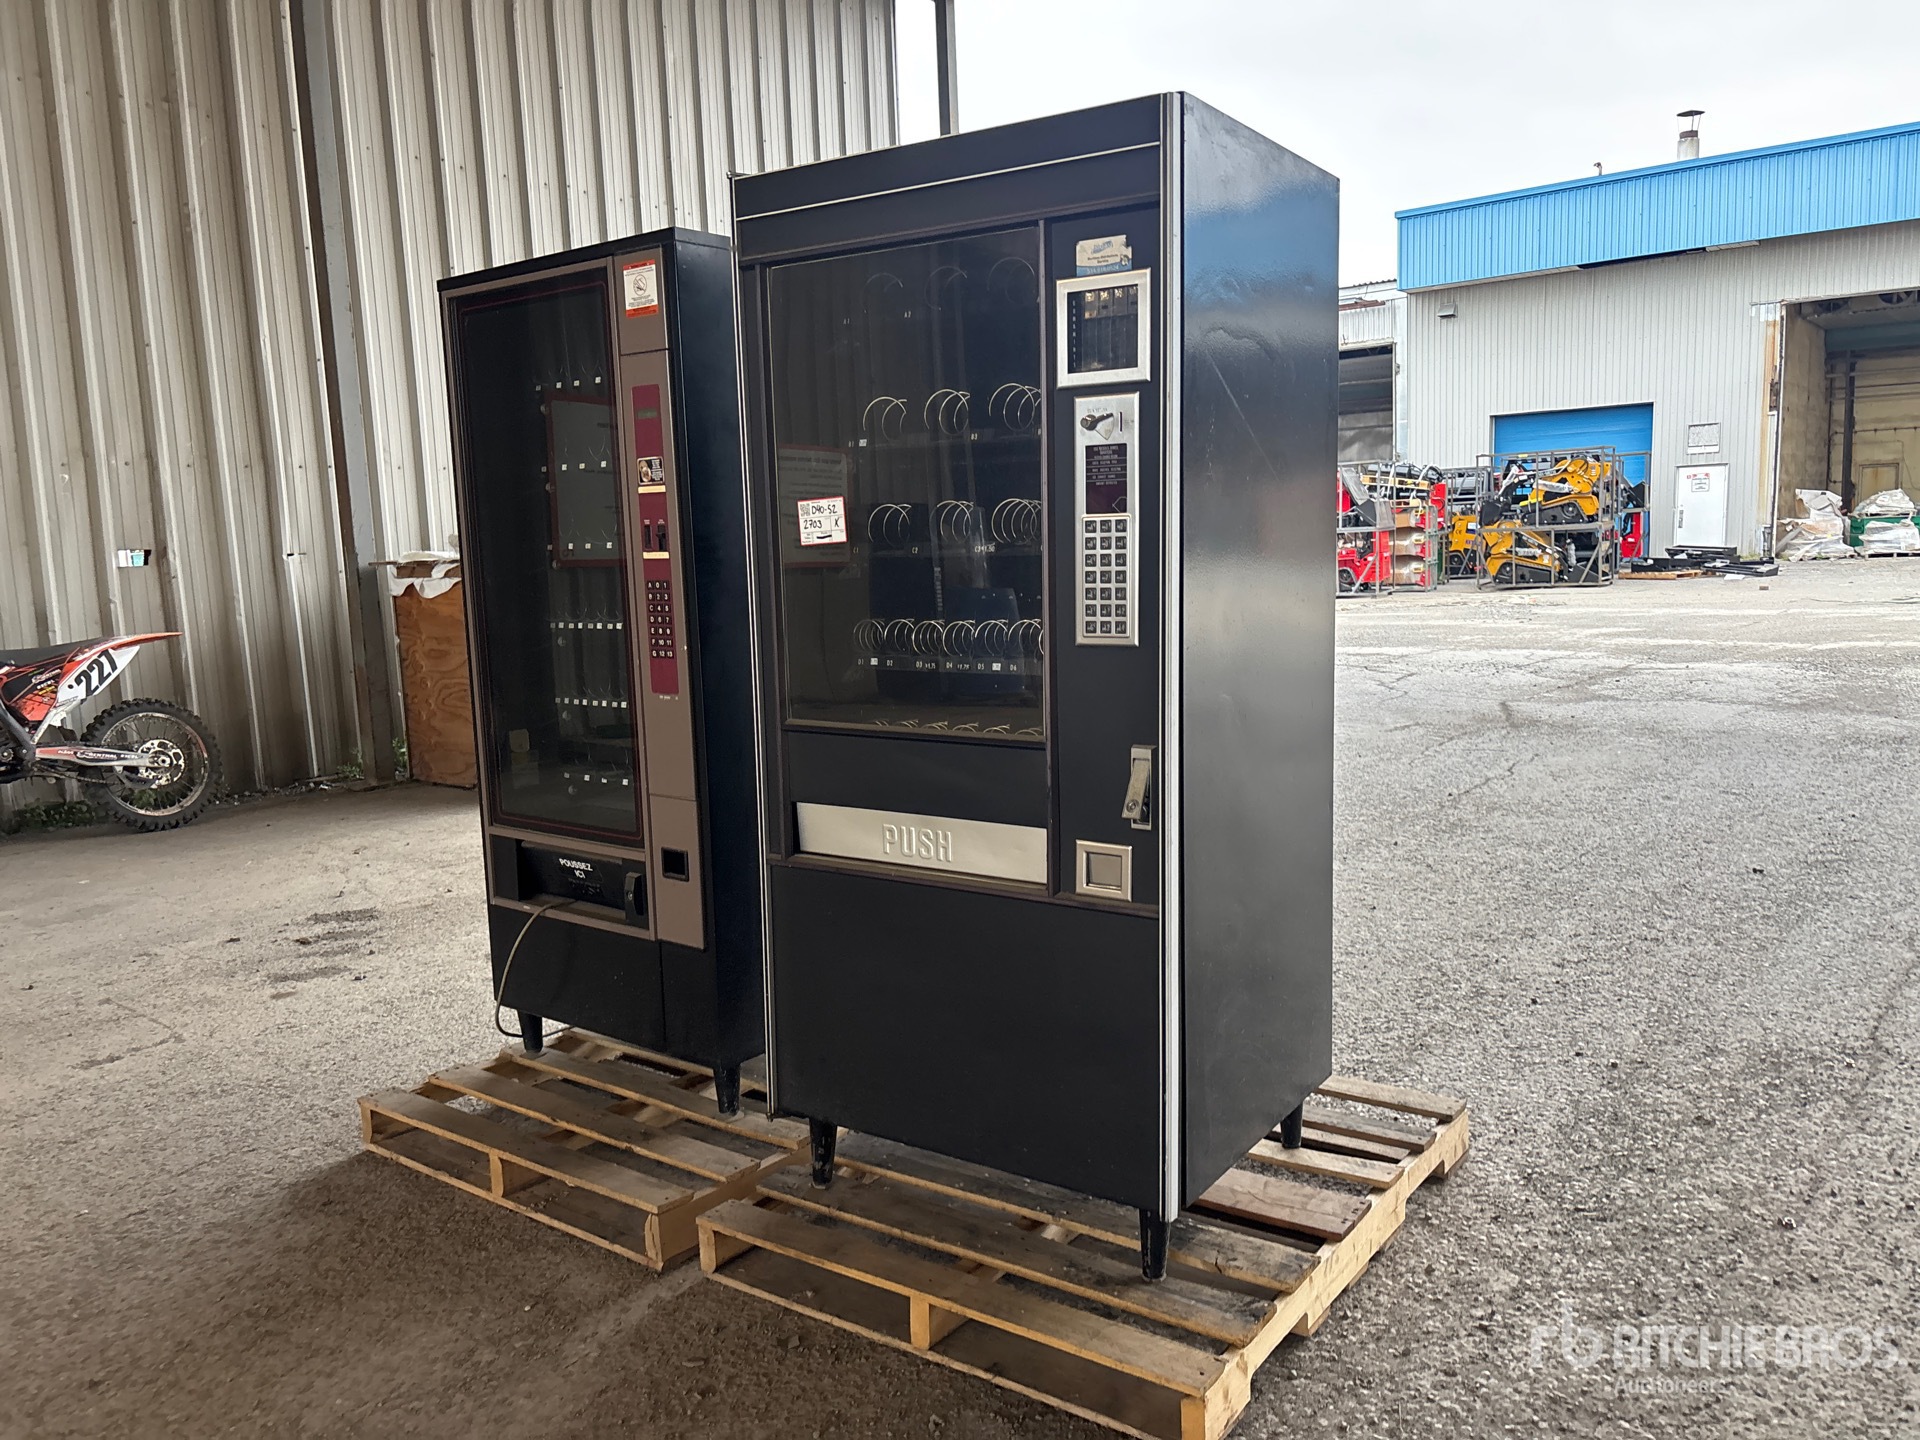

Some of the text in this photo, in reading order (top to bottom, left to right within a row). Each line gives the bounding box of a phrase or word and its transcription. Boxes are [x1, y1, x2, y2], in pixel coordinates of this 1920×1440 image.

[811, 504, 838, 515] D40-52
[803, 519, 823, 530] 2703
[74, 648, 118, 698] 227
[882, 823, 952, 863] PUSH
[558, 857, 594, 872] POUSSEZ
[573, 869, 586, 879] ICI
